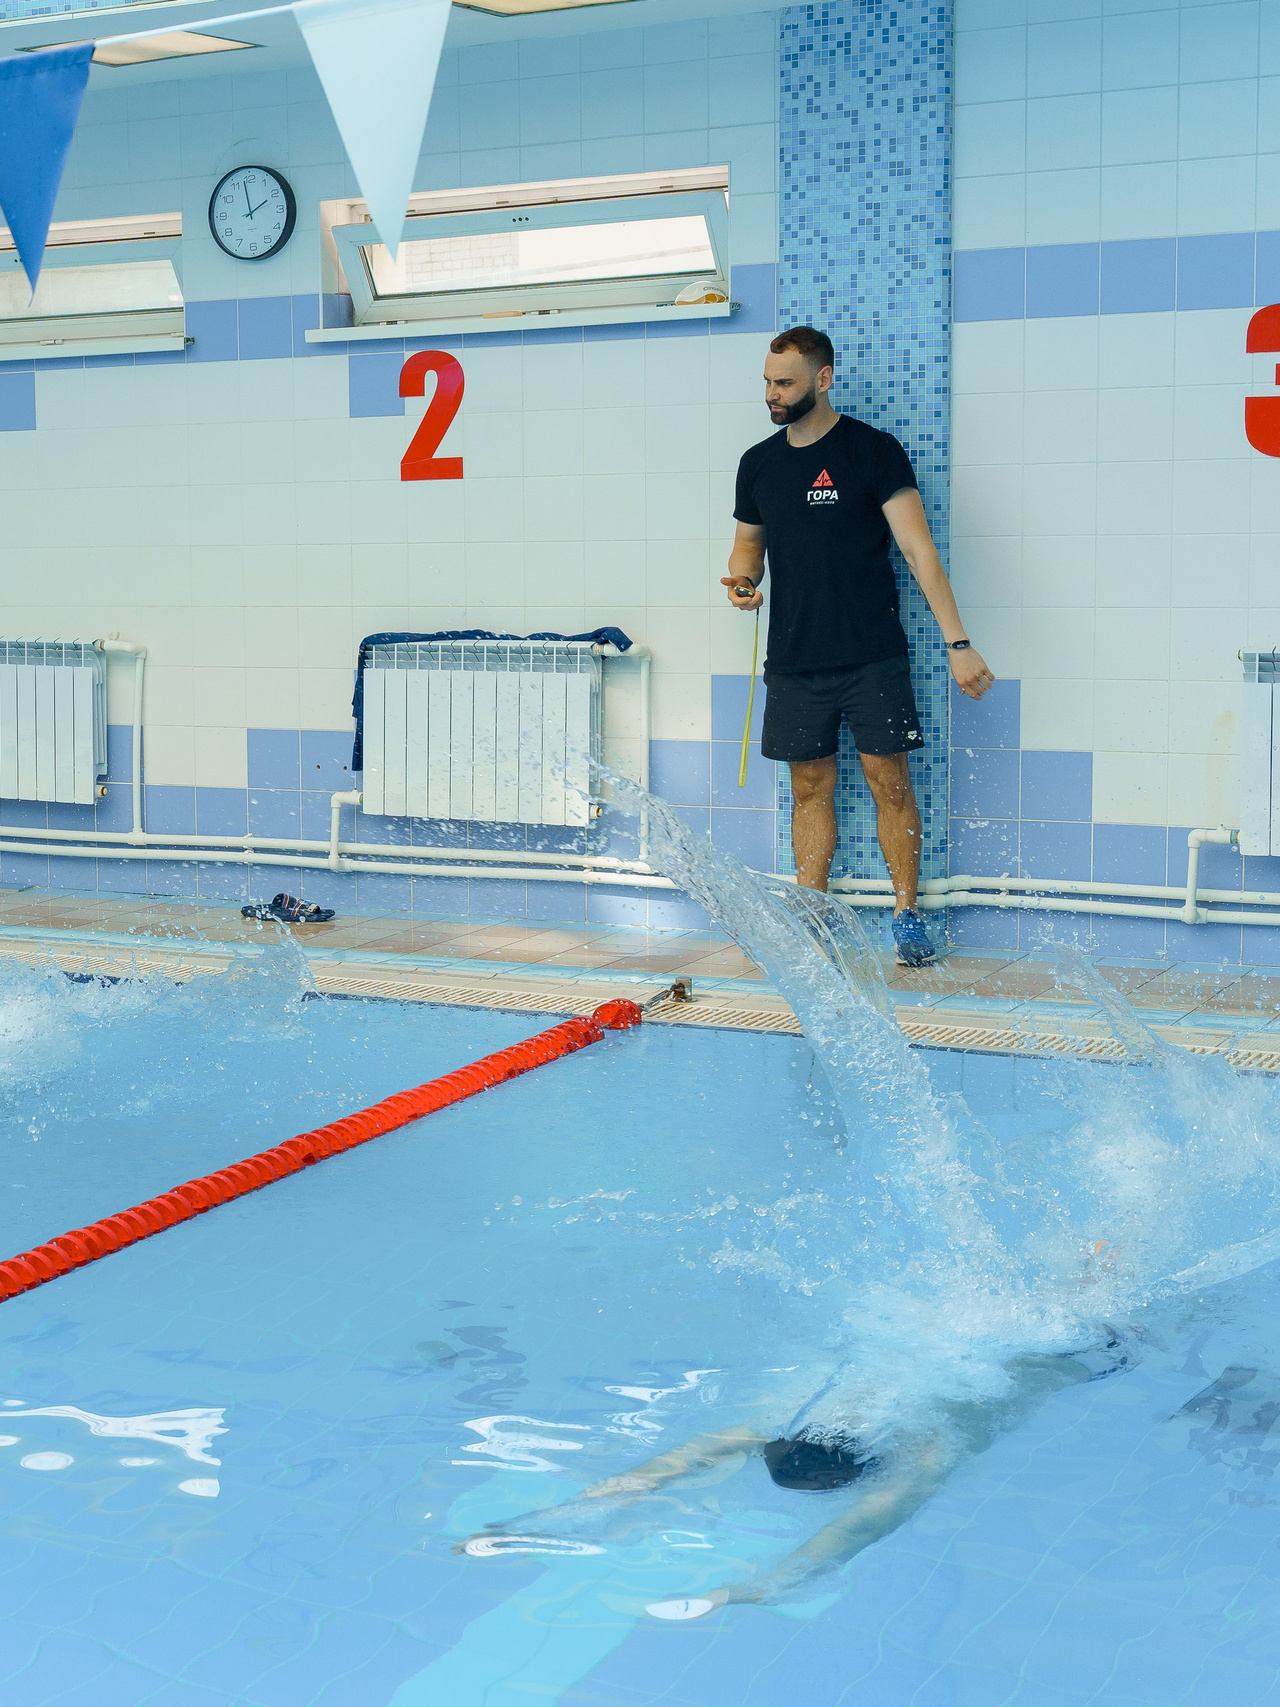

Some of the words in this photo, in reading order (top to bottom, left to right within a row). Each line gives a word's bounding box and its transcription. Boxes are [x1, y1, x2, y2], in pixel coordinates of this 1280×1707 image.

[244, 175, 256, 184] 12
[231, 182, 240, 190] 11
[271, 189, 279, 198] 2
[222, 195, 234, 204] 10
[276, 205, 284, 213] 3
[220, 212, 227, 220] 9
[225, 228, 232, 236] 8
[236, 239, 243, 247] 7
[264, 235, 272, 244] 5
[250, 243, 257, 251] 6
[399, 350, 465, 481] 2
[807, 490, 838, 501] ГОРА
